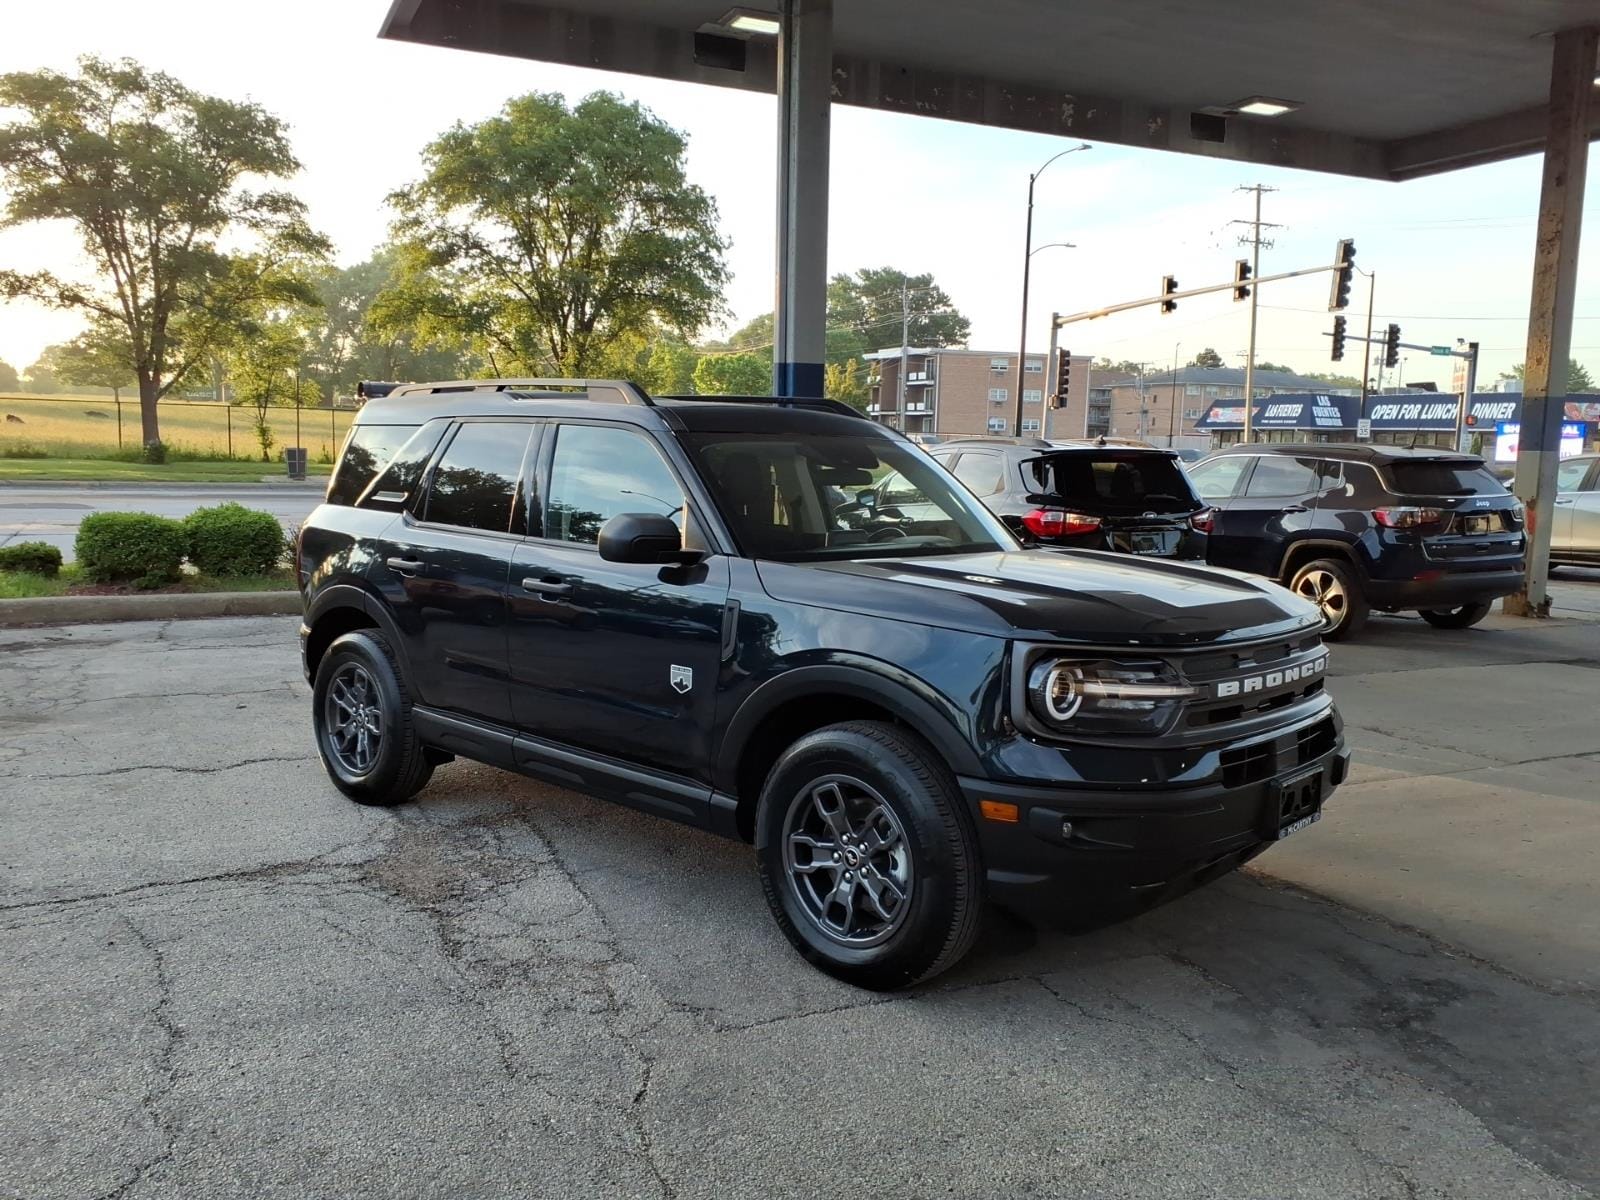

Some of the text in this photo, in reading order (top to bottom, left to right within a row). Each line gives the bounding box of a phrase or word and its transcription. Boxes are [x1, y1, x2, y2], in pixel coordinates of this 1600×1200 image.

[1371, 402, 1516, 420] OPEN FOR LUNCH DINNER
[1217, 657, 1325, 698] BRONCO
